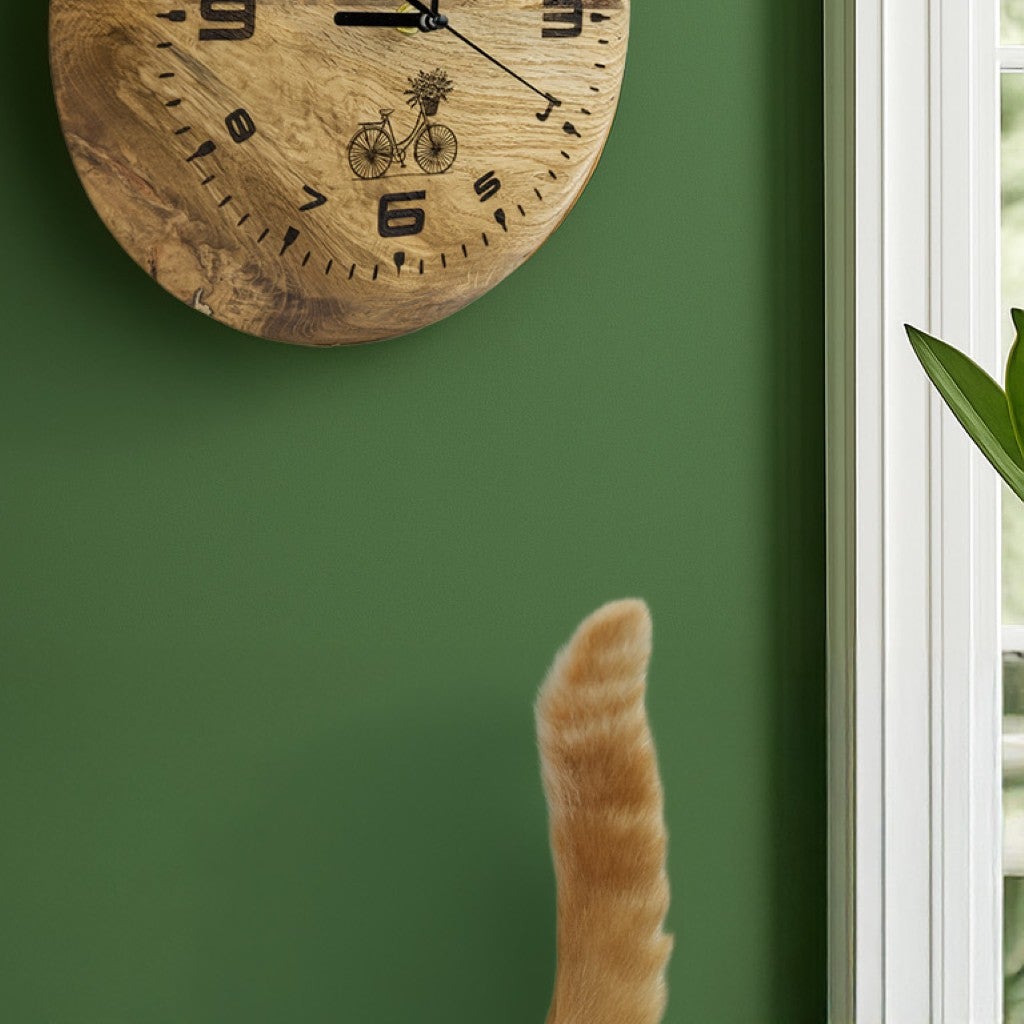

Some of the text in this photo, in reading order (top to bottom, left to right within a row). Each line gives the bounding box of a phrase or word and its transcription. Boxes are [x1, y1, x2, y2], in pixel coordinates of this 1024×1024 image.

[225, 108, 256, 144] 8
[299, 184, 328, 212] 7
[474, 170, 501, 203] 5
[378, 190, 426, 238] 6
